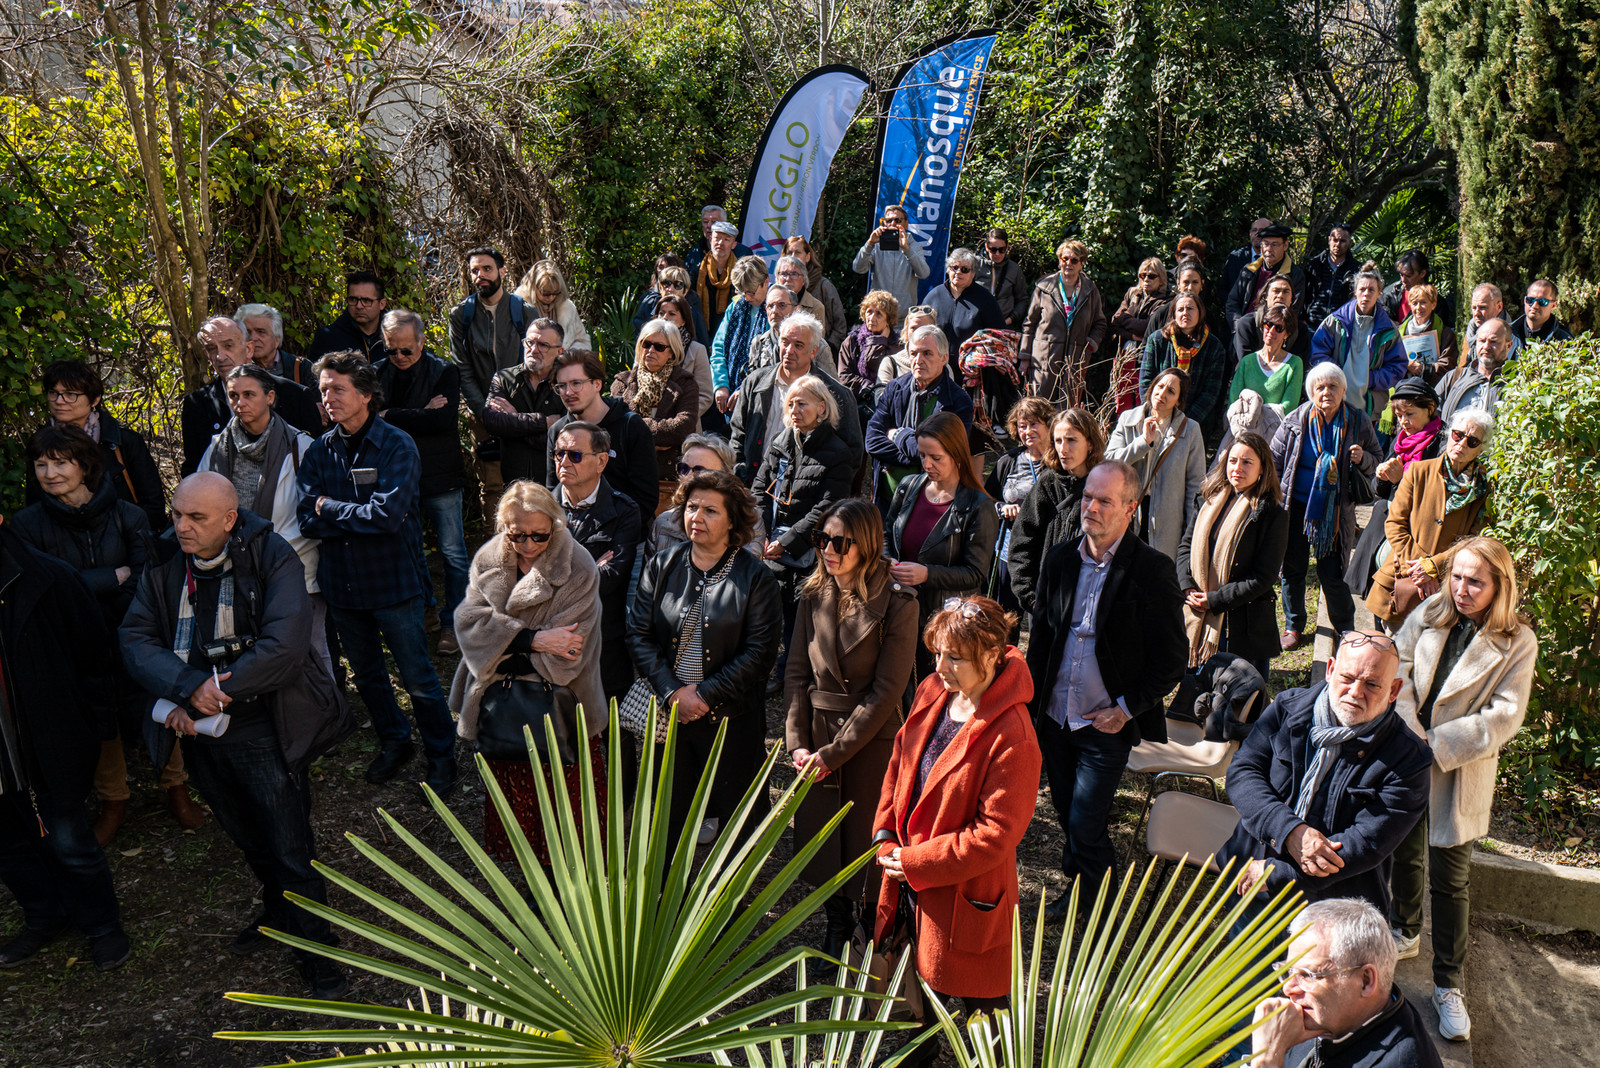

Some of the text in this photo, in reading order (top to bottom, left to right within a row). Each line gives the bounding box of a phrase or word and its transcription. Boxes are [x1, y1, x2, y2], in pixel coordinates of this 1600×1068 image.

[908, 66, 965, 256] Manosque
[953, 127, 966, 167] HAUTE
[963, 54, 985, 116] PROVENCE
